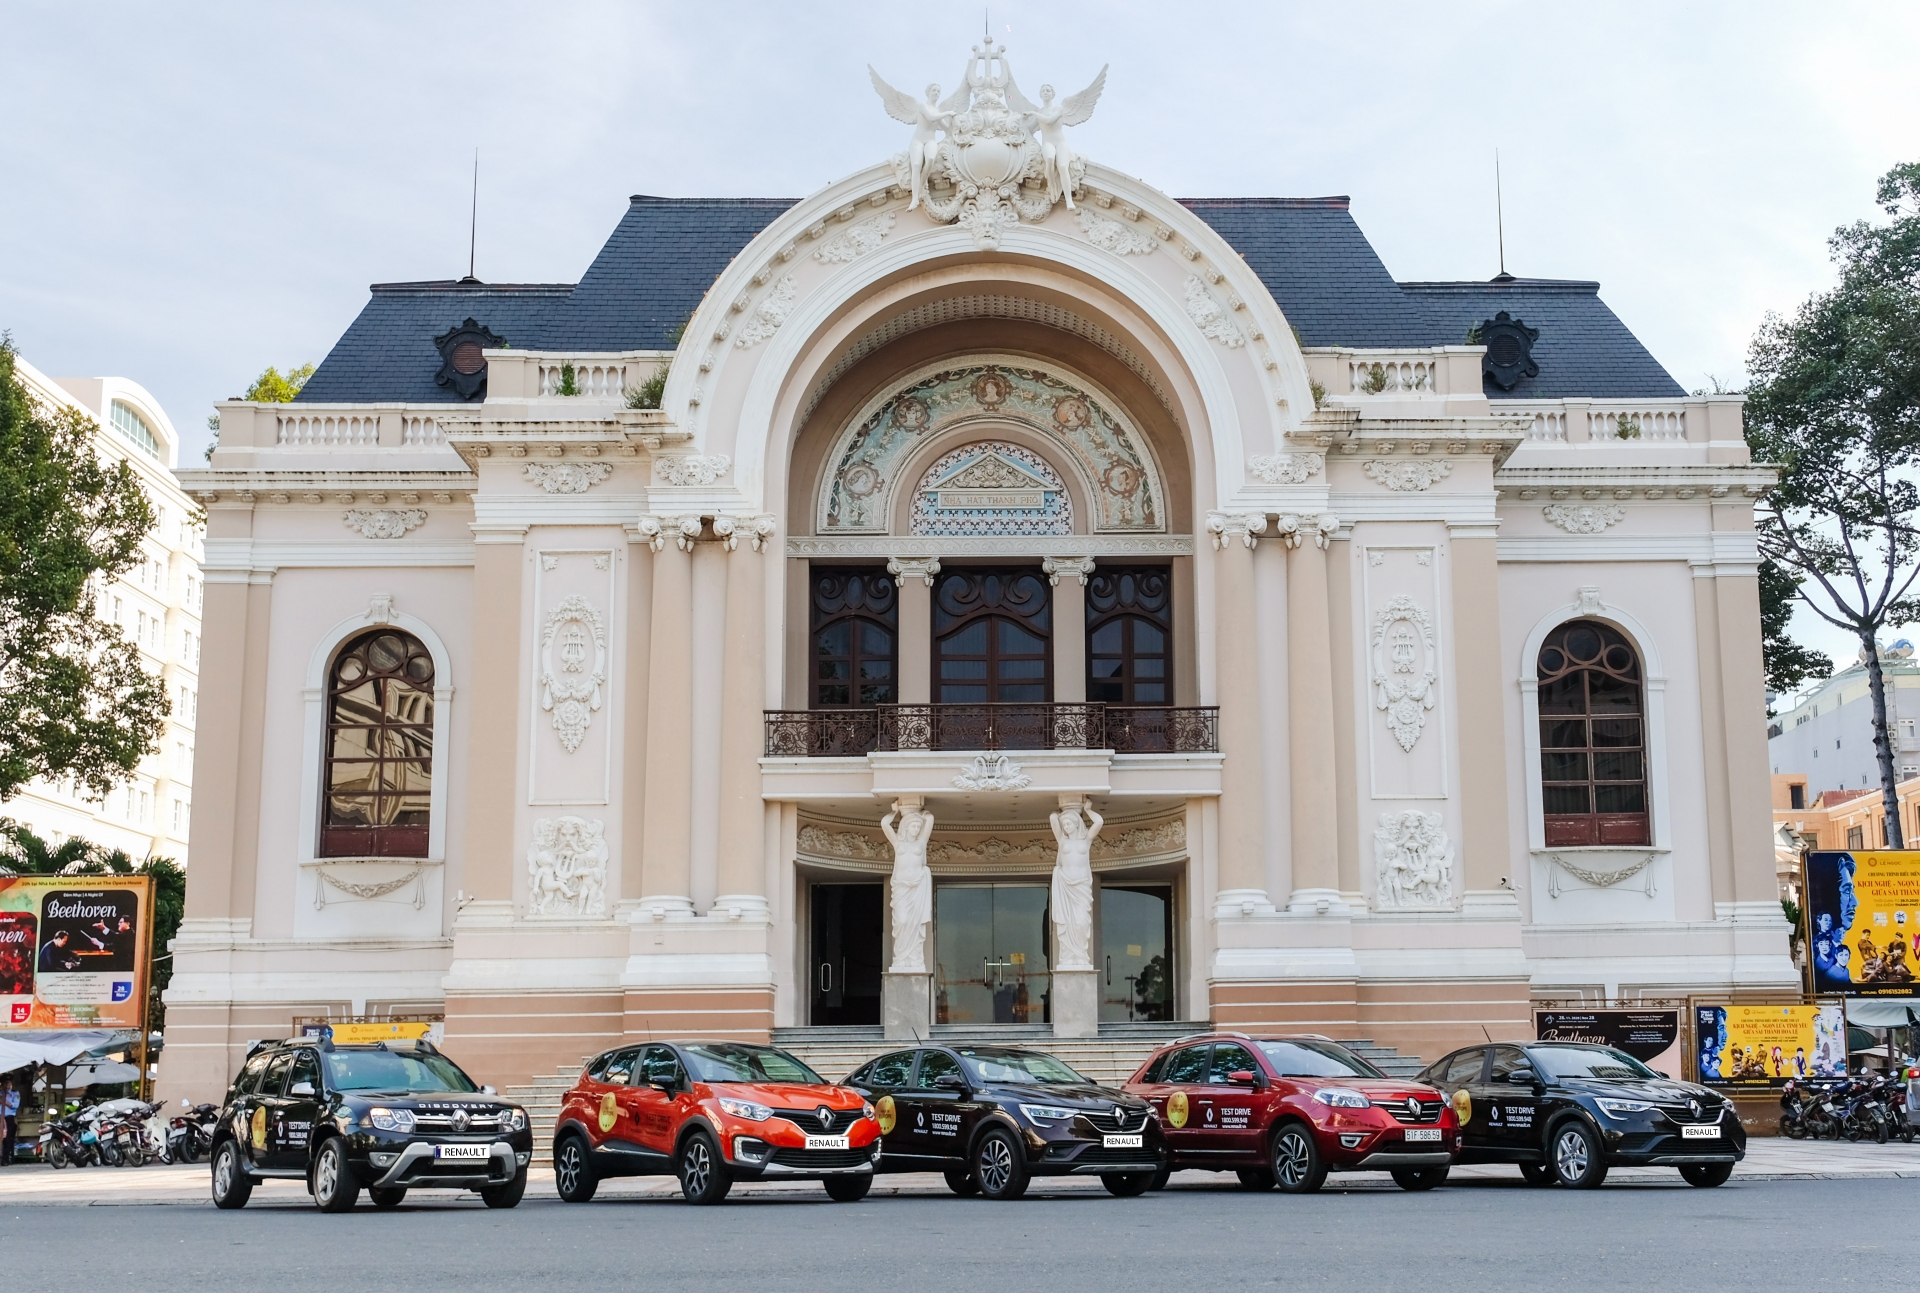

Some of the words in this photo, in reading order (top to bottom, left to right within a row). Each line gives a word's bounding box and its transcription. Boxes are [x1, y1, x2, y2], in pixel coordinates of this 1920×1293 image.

[48, 899, 117, 918] Beethoven
[1541, 1029, 1606, 1044] Beethoven
[945, 1114, 961, 1122] DRIVE
[445, 1148, 486, 1156] RENAULT
